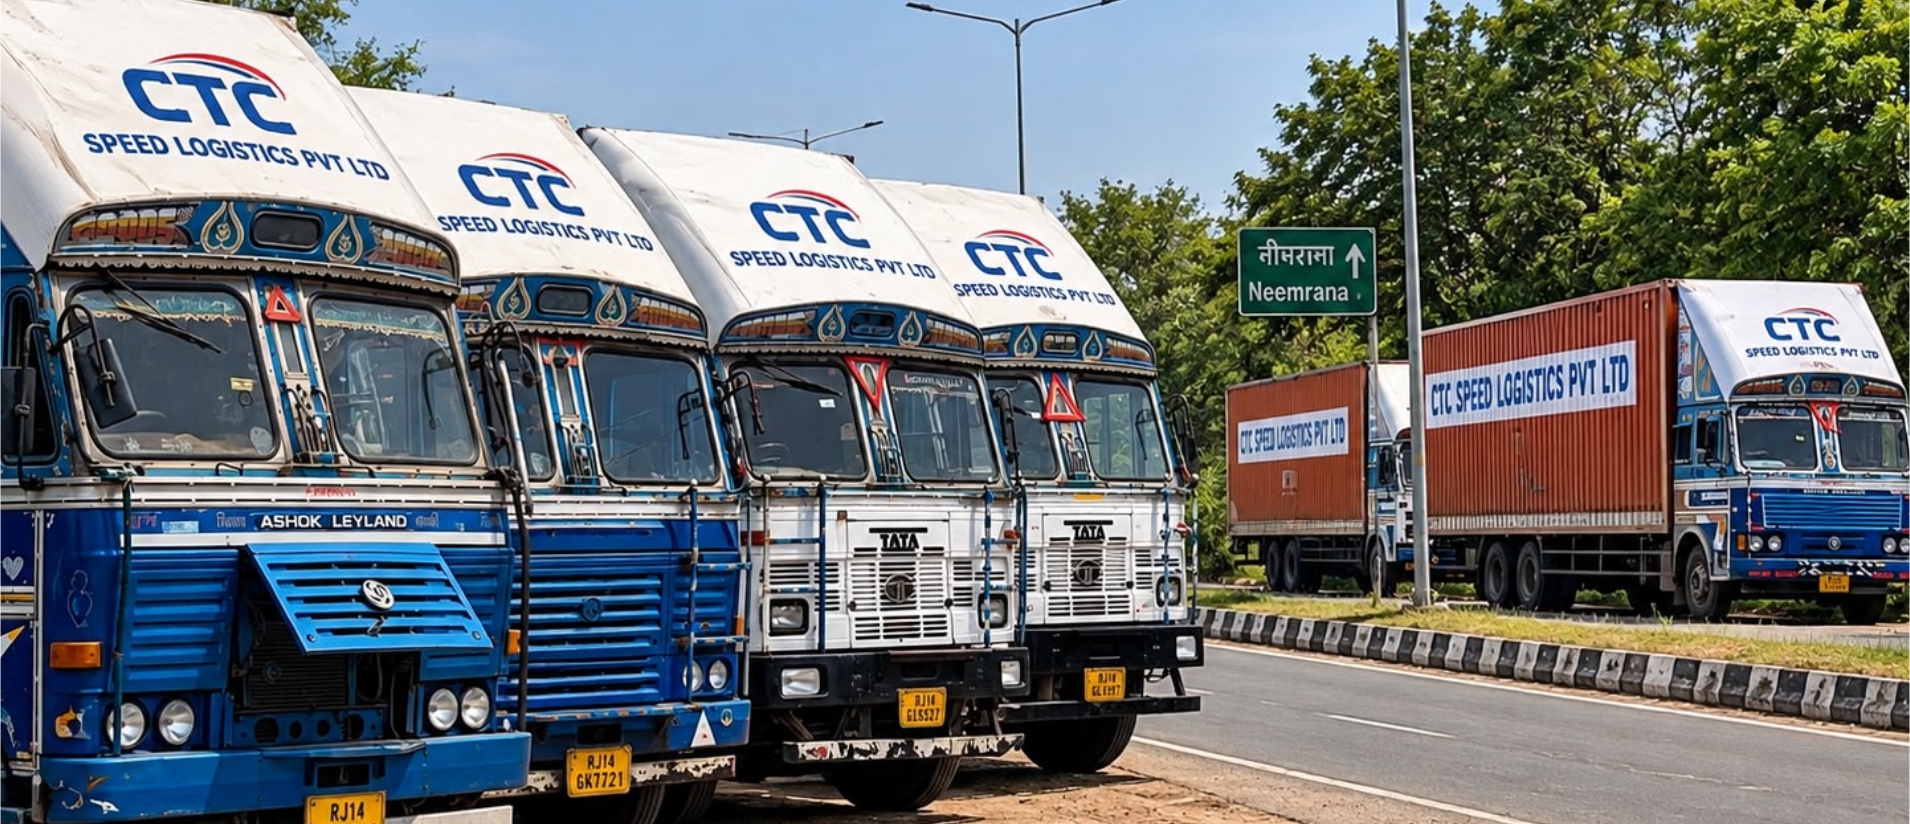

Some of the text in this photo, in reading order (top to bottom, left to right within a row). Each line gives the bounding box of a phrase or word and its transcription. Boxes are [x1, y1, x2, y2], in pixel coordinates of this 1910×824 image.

[122, 68, 297, 135] CTC
[83, 133, 390, 181] SPEED LOGISTICS PVT LTD
[458, 164, 585, 217] CTC
[437, 215, 654, 251] SPEED LOGISTICS PVT LTD
[750, 202, 871, 249] CTC
[730, 251, 936, 280] SPEED LOGISTICS PVT LTD
[964, 241, 1063, 281] CTC
[953, 283, 1116, 306] SPEED LOGISTICS PVT LTD
[1248, 281, 1349, 302] Neemrana
[1764, 317, 1841, 342] CTC
[1745, 346, 1879, 359] SPEED LOGISTICS PVT LTD
[1431, 354, 1630, 417] CTC SPEED LOGISTICS PVT LTD
[1240, 429, 1253, 454] CTC
[1254, 426, 1275, 453] SPEED
[1314, 419, 1329, 446] PVT
[1330, 416, 1346, 445] LTD
[260, 514, 322, 528] ASHOK
[332, 514, 408, 528] LEYLAND
[1072, 525, 1106, 540] TATA
[880, 533, 919, 551] TATA
[587, 753, 614, 770] RJ14
[576, 771, 623, 790] GK7721
[330, 801, 365, 822] RJ14
